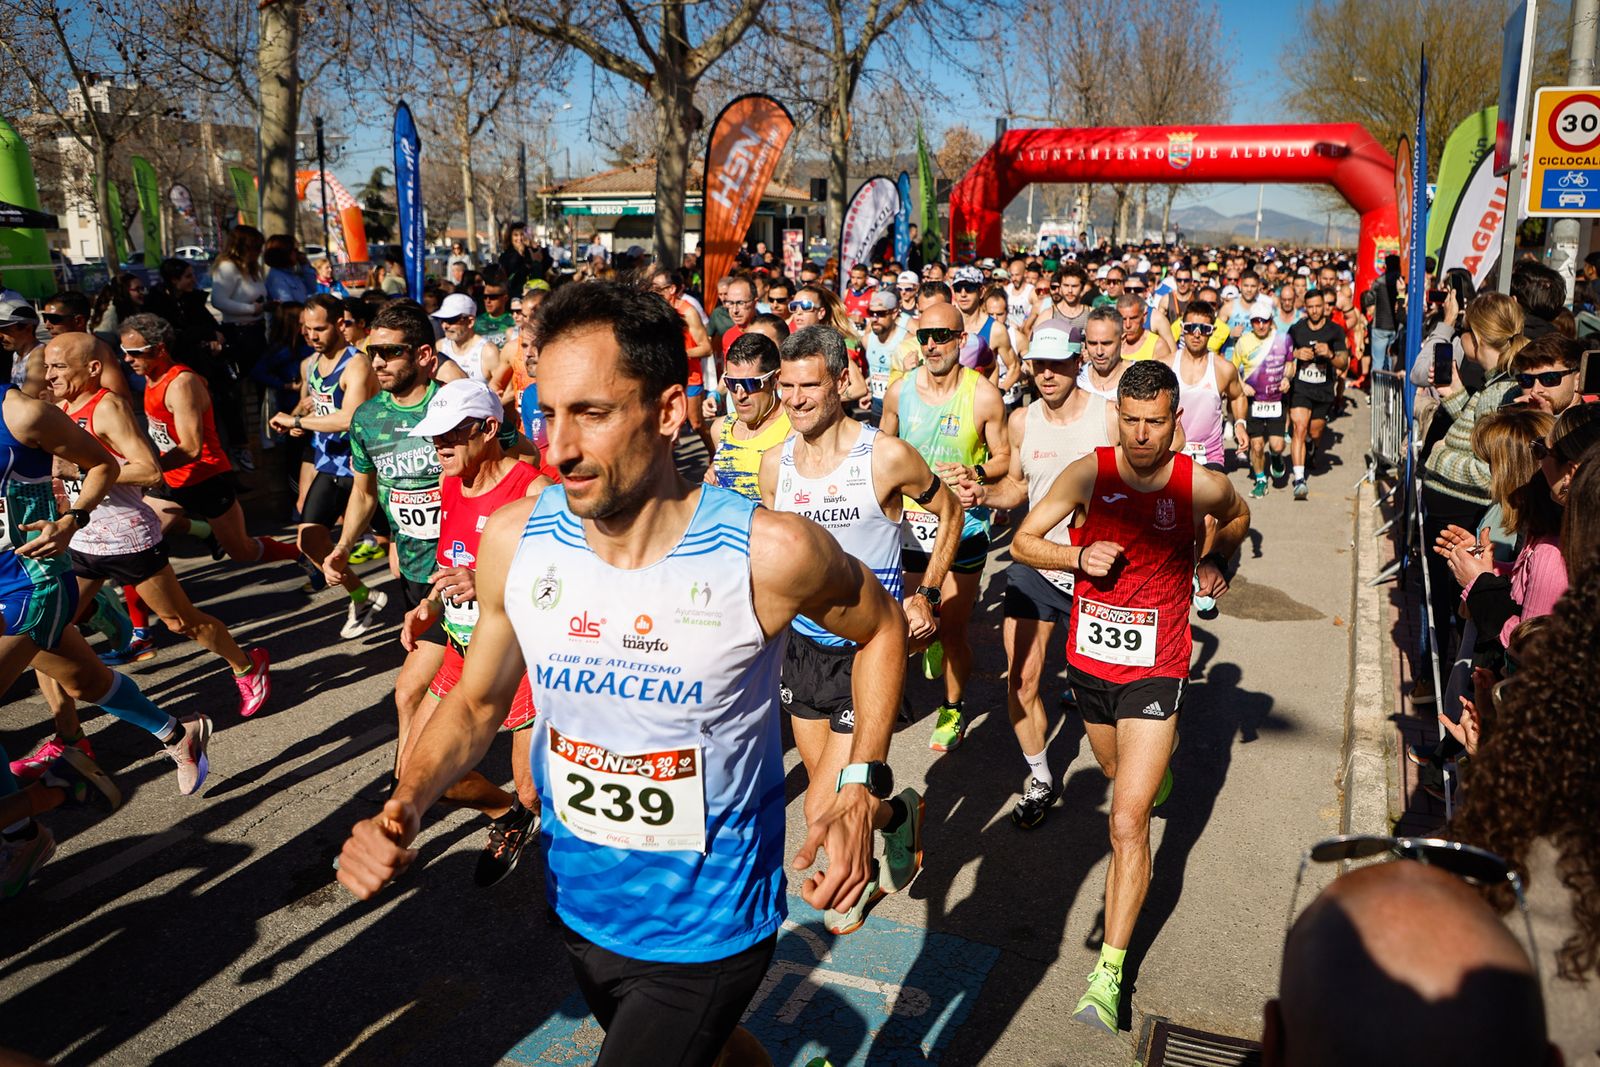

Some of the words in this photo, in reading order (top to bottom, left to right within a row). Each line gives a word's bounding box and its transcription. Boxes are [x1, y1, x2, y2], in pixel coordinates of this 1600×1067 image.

[1561, 113, 1598, 133] 30
[1016, 147, 1164, 161] AYUNTAMIENTO
[1195, 147, 1219, 159] DE
[1538, 156, 1600, 166] CICLOCAL
[711, 122, 762, 209] HSN
[399, 505, 441, 527] 507
[1085, 603, 1097, 614] 39
[1095, 608, 1136, 623] FONDO
[682, 616, 722, 627] Maracena
[623, 638, 669, 653] mayfo
[1087, 621, 1142, 651] 339
[549, 653, 580, 664] CLUB
[584, 657, 602, 667] DE
[605, 658, 682, 675] ATLETISMO
[536, 663, 703, 705] MARACENA
[556, 736, 575, 757] 39
[574, 750, 656, 778] FONDO
[656, 756, 673, 768] 20
[659, 765, 677, 778] 26
[566, 772, 675, 826] 239
